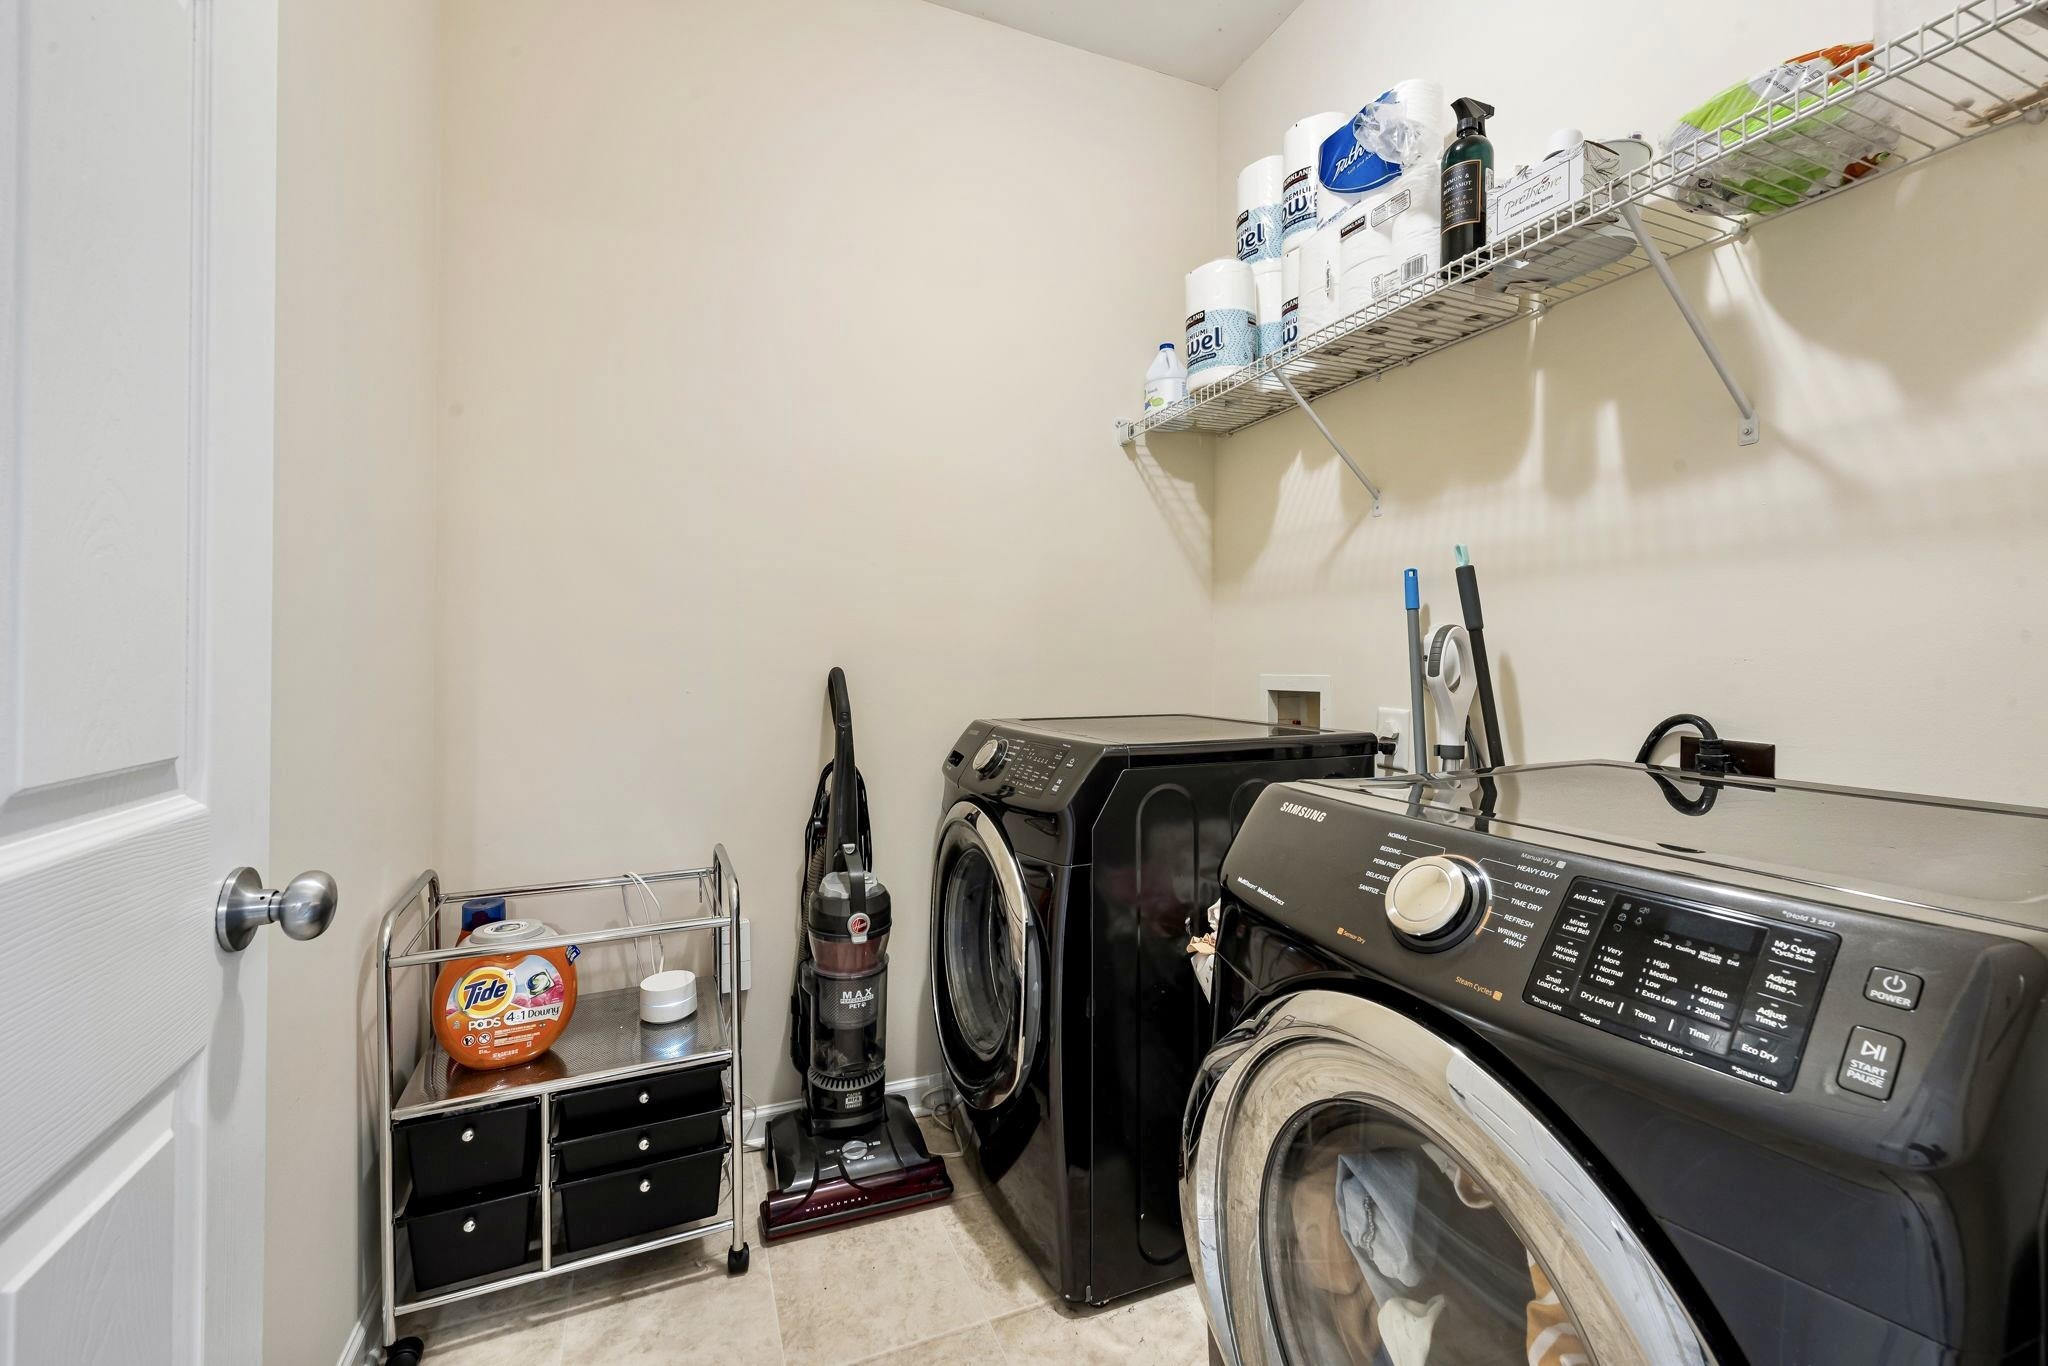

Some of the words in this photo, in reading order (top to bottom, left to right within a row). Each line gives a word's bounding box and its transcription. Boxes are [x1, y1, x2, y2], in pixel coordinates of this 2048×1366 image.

[1444, 175, 1463, 187] LEMON
[1280, 801, 1327, 823] SAMSUNG
[1388, 832, 1408, 842] NORMAL
[1380, 845, 1401, 855] BEDDING
[1373, 858, 1387, 867] PERM
[1521, 852, 1543, 863] Manual
[1543, 857, 1556, 867] Dry
[1366, 870, 1390, 883] DELICATES
[1517, 864, 1540, 875] HEAVY
[1540, 870, 1559, 880] DUTY
[1358, 883, 1380, 895] SANITIZE
[1514, 881, 1535, 893] QUICK
[1535, 887, 1551, 896] DRY
[1510, 897, 1527, 908] TIME
[1527, 903, 1543, 912] DRY
[1573, 893, 1587, 902] Anti
[1587, 896, 1606, 906] Static
[1504, 913, 1535, 928] REFRESH
[1569, 918, 1589, 928] Mixed
[1497, 926, 1528, 942] WRINKLE
[1562, 923, 1577, 932] Load
[1577, 927, 1590, 936] Bell
[1503, 937, 1524, 949] AWAY
[1653, 938, 1672, 949] Drying
[1774, 940, 1790, 950] My
[1790, 943, 1817, 957] Cycle
[1555, 945, 1579, 957] Wrinkle
[1607, 946, 1623, 956] Very
[1675, 944, 1696, 955] Cooling
[1699, 950, 1722, 961] Wrinkle
[1552, 951, 1577, 964] Prevent
[1603, 956, 1620, 966] More
[1698, 954, 1721, 965] Prevent
[1727, 959, 1740, 967] End
[1795, 953, 1814, 964] Save
[1653, 959, 1670, 970] High
[1599, 965, 1624, 977] Normal
[1649, 969, 1678, 983] Medium
[1537, 979, 1551, 989] Load
[1545, 974, 1562, 984] Small
[1595, 975, 1615, 986] Damp
[1645, 979, 1661, 989] Low
[1767, 973, 1797, 988] Adjust
[1456, 976, 1473, 988] Steam
[1473, 983, 1492, 996] Cycles
[1765, 980, 1787, 993] Time
[464, 980, 508, 1010] Tide
[842, 987, 872, 999] MAX
[1580, 990, 1595, 1001] Dry
[1594, 996, 1614, 1008] Level
[1641, 989, 1661, 1001] Extra
[1661, 995, 1678, 1006] Low
[1870, 989, 1912, 1007] POWER
[528, 1006, 560, 1018] Downy
[1548, 1002, 1562, 1011] Light
[1757, 1007, 1787, 1022] Adjust
[468, 1017, 502, 1031] PODS
[1755, 1014, 1778, 1028] Time
[1688, 1027, 1710, 1041] Time
[1667, 1044, 1684, 1055] Lock
[1741, 1043, 1759, 1056] Eco
[1759, 1050, 1779, 1063] Dry
[1850, 1059, 1888, 1077] START
[1759, 1075, 1778, 1087] Care
[1846, 1069, 1885, 1088] PAUSE
